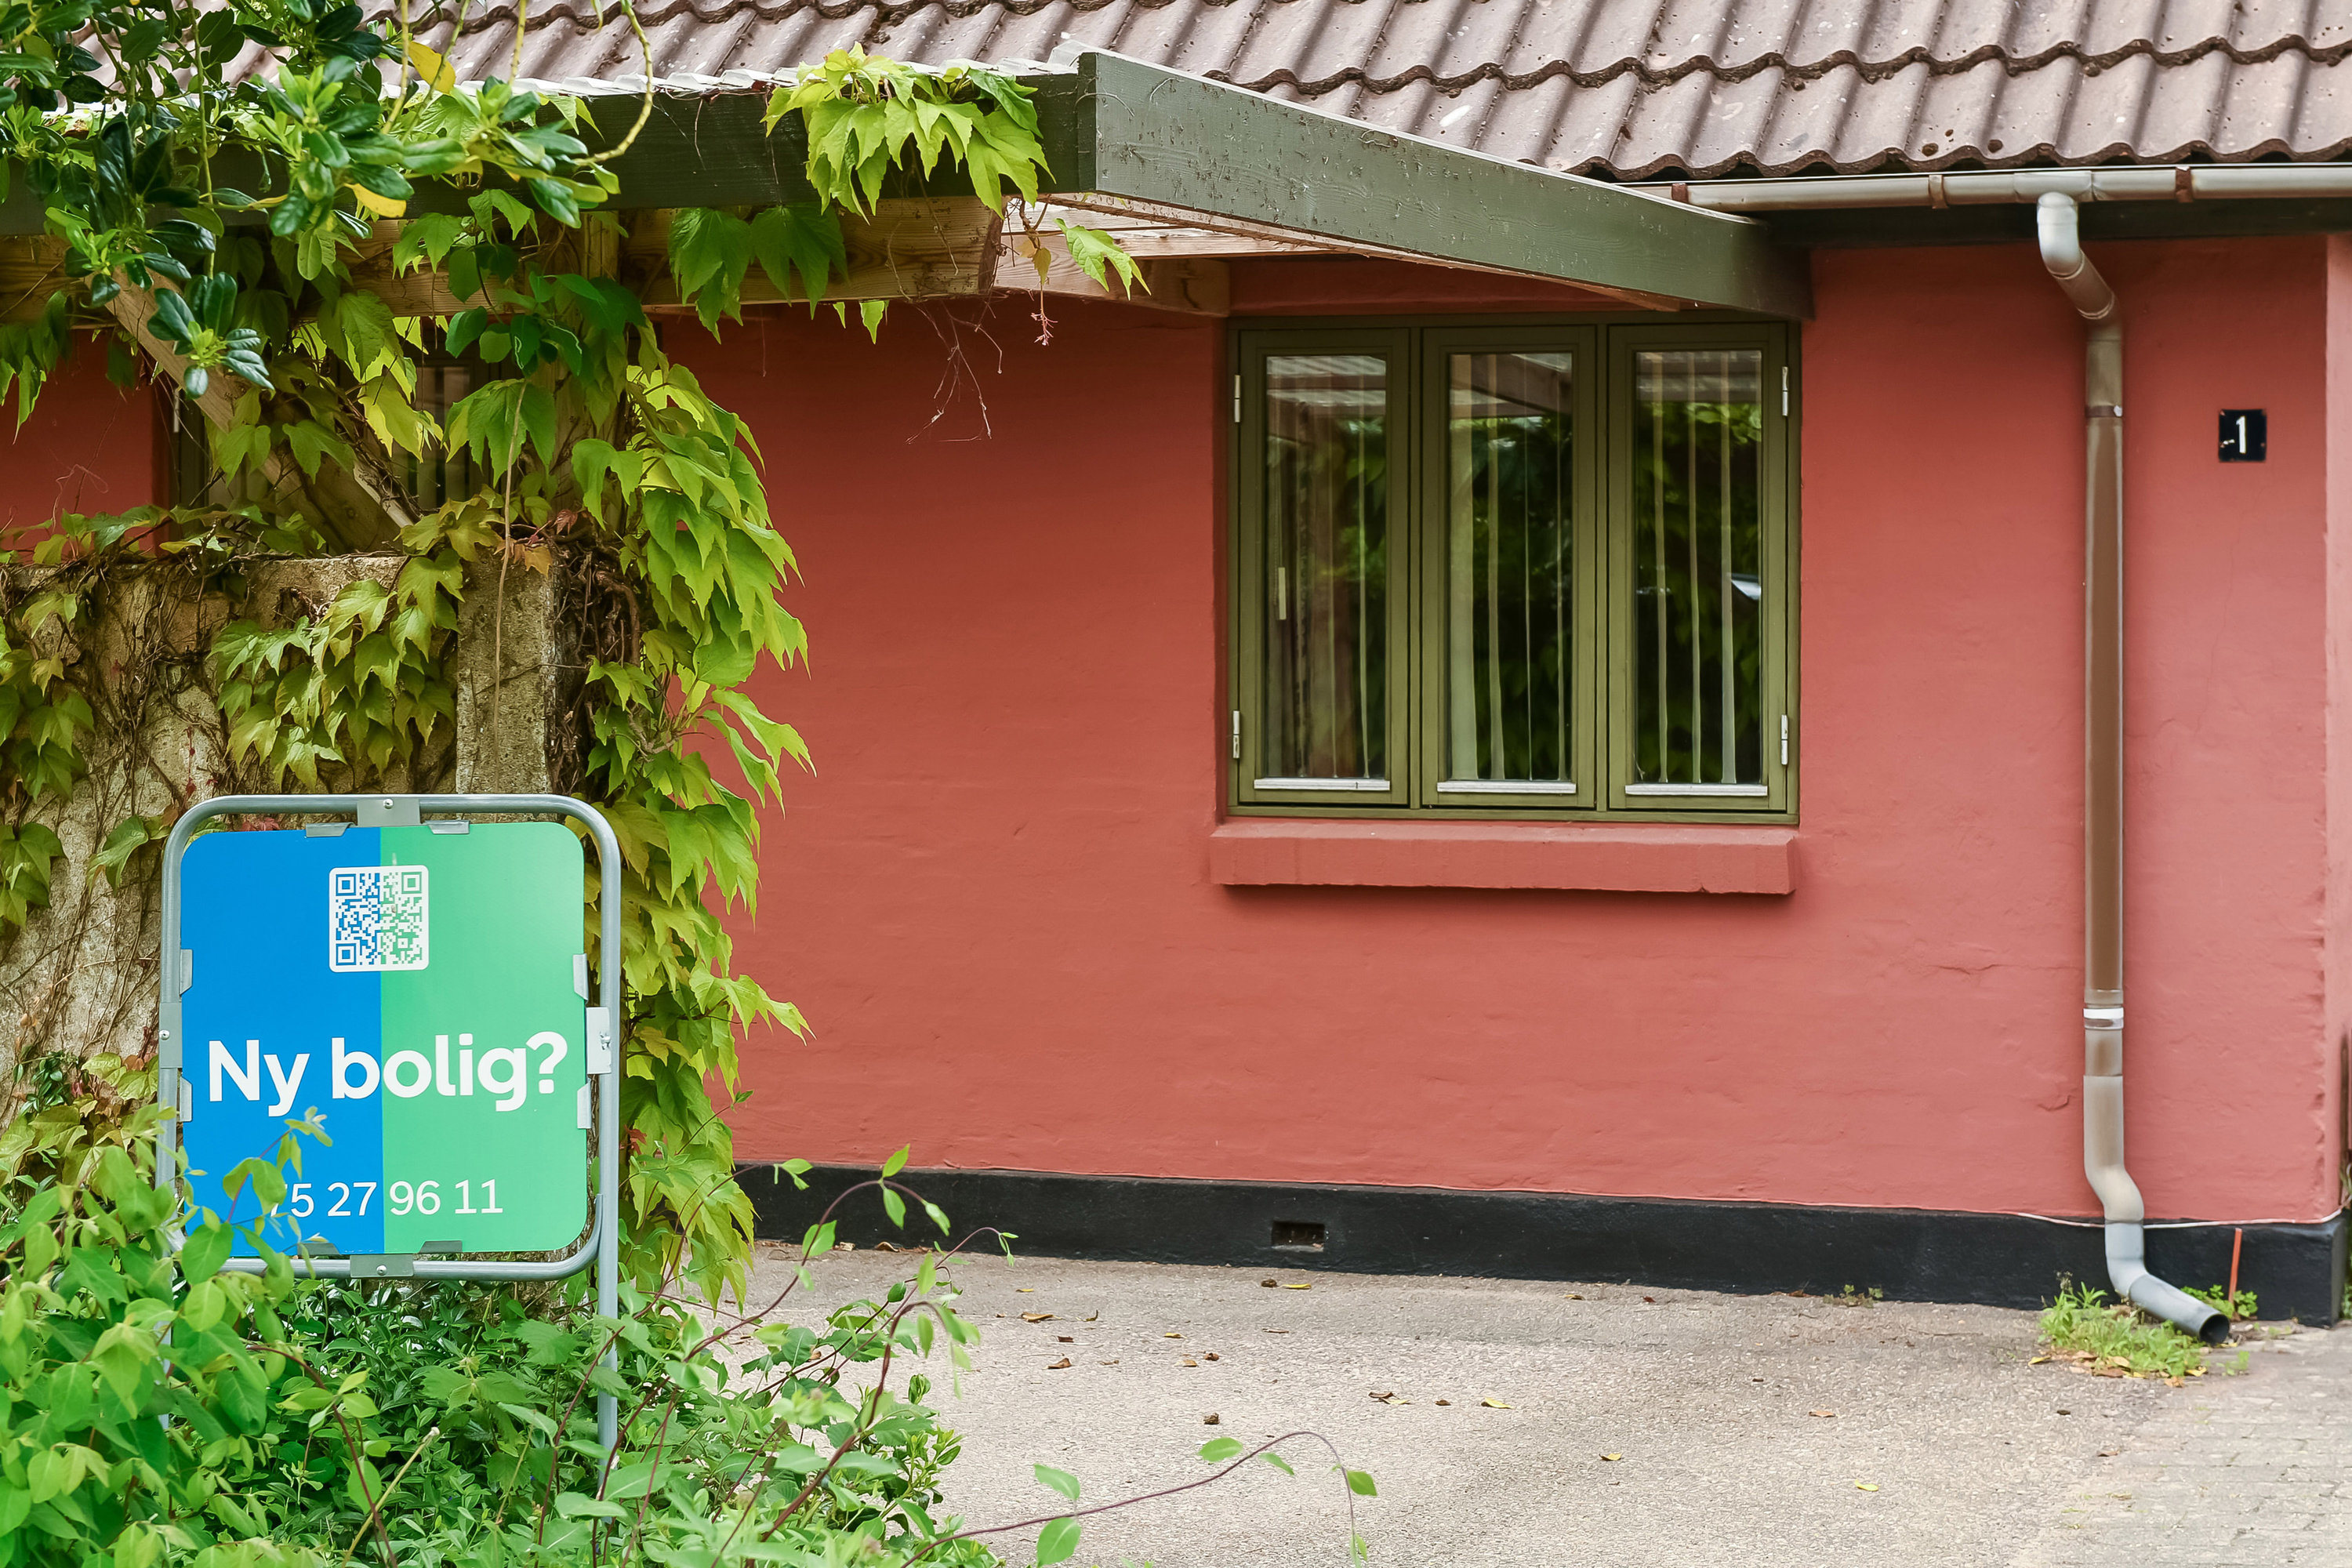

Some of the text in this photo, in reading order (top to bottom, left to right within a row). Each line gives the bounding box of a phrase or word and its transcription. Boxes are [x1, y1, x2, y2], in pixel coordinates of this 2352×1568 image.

[2235, 416, 2246, 454] 1
[208, 1030, 569, 1117] Ny bolig?
[327, 1181, 378, 1217] 27
[389, 1180, 441, 1216] 96
[455, 1178, 504, 1214] 11
